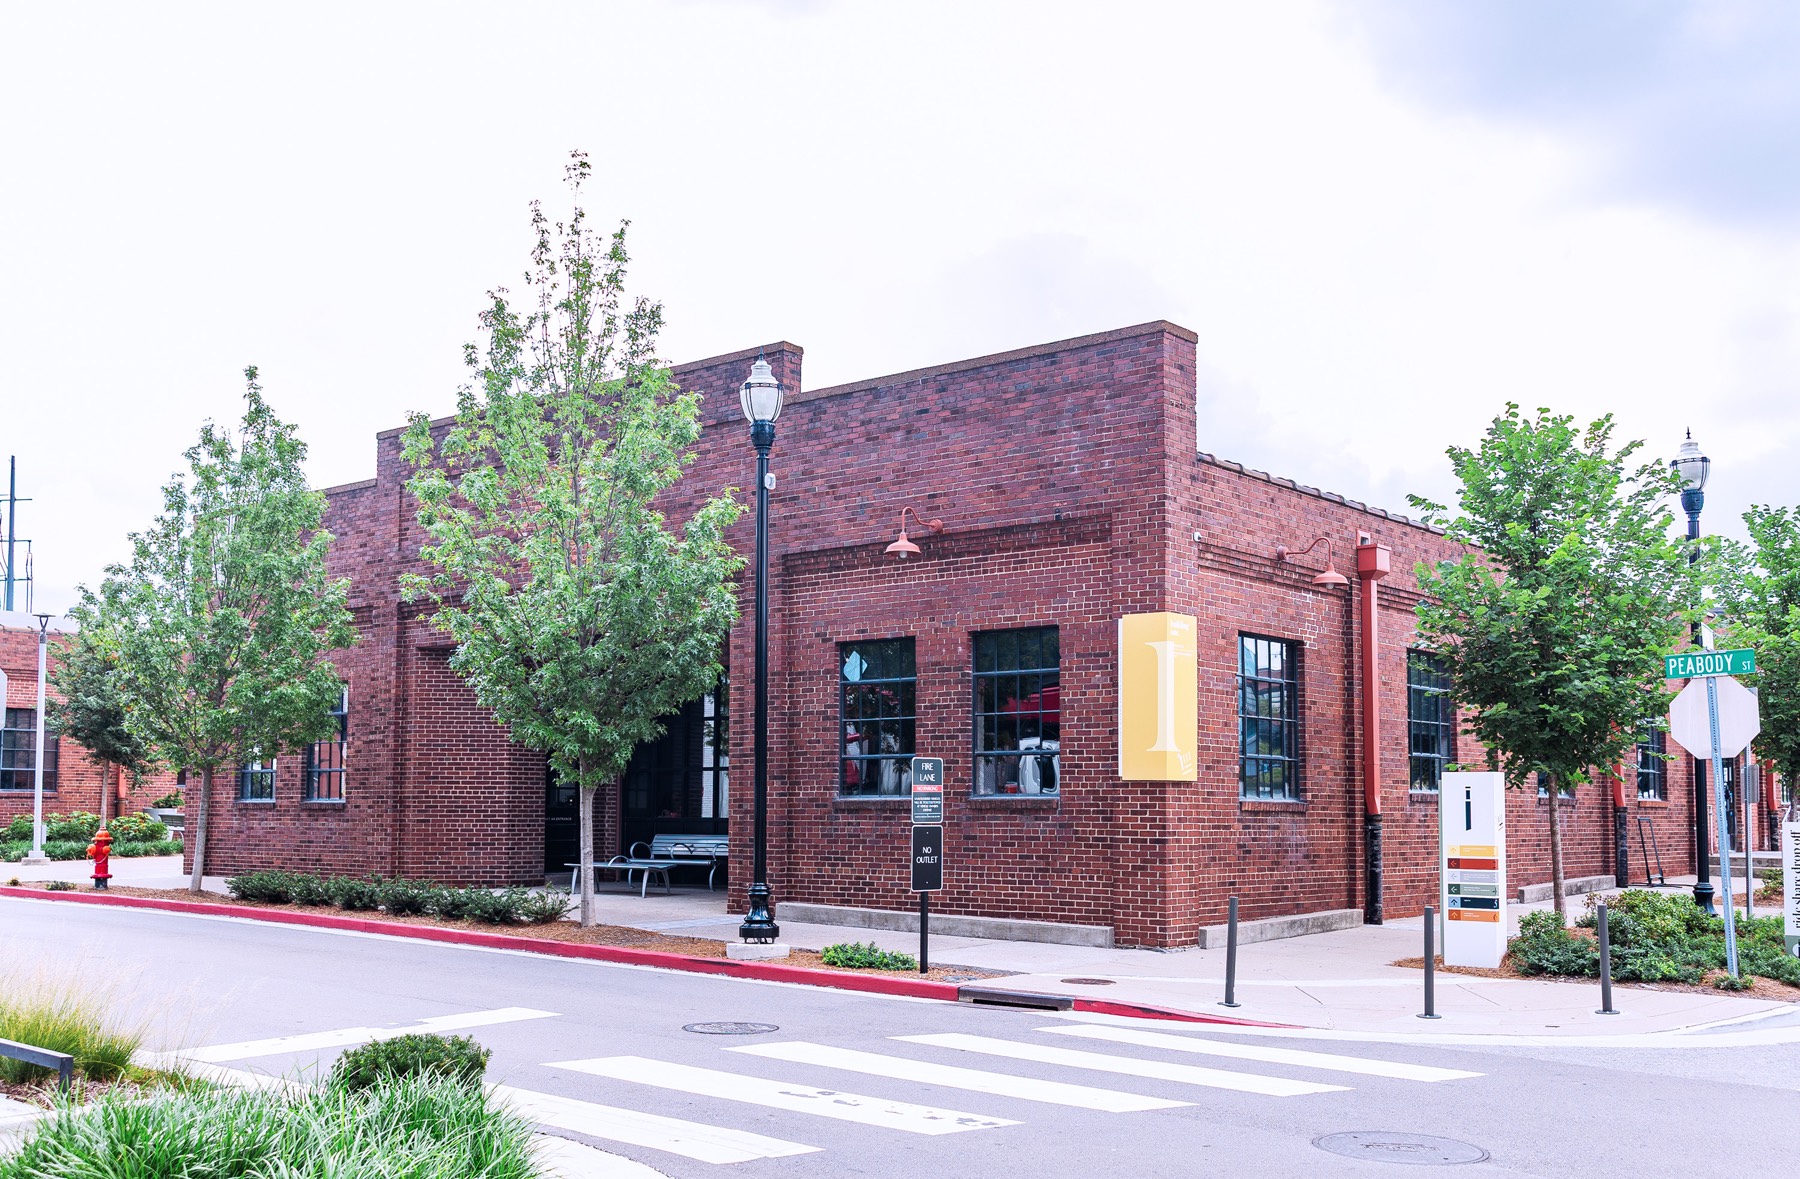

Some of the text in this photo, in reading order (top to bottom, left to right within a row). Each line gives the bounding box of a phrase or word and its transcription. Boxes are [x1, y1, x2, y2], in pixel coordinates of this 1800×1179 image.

[1668, 654, 1751, 676] PEABODY ST
[921, 762, 934, 771] FIRE
[919, 773, 936, 782] LANE
[922, 846, 932, 854] NO
[916, 855, 938, 864] OUTLET
